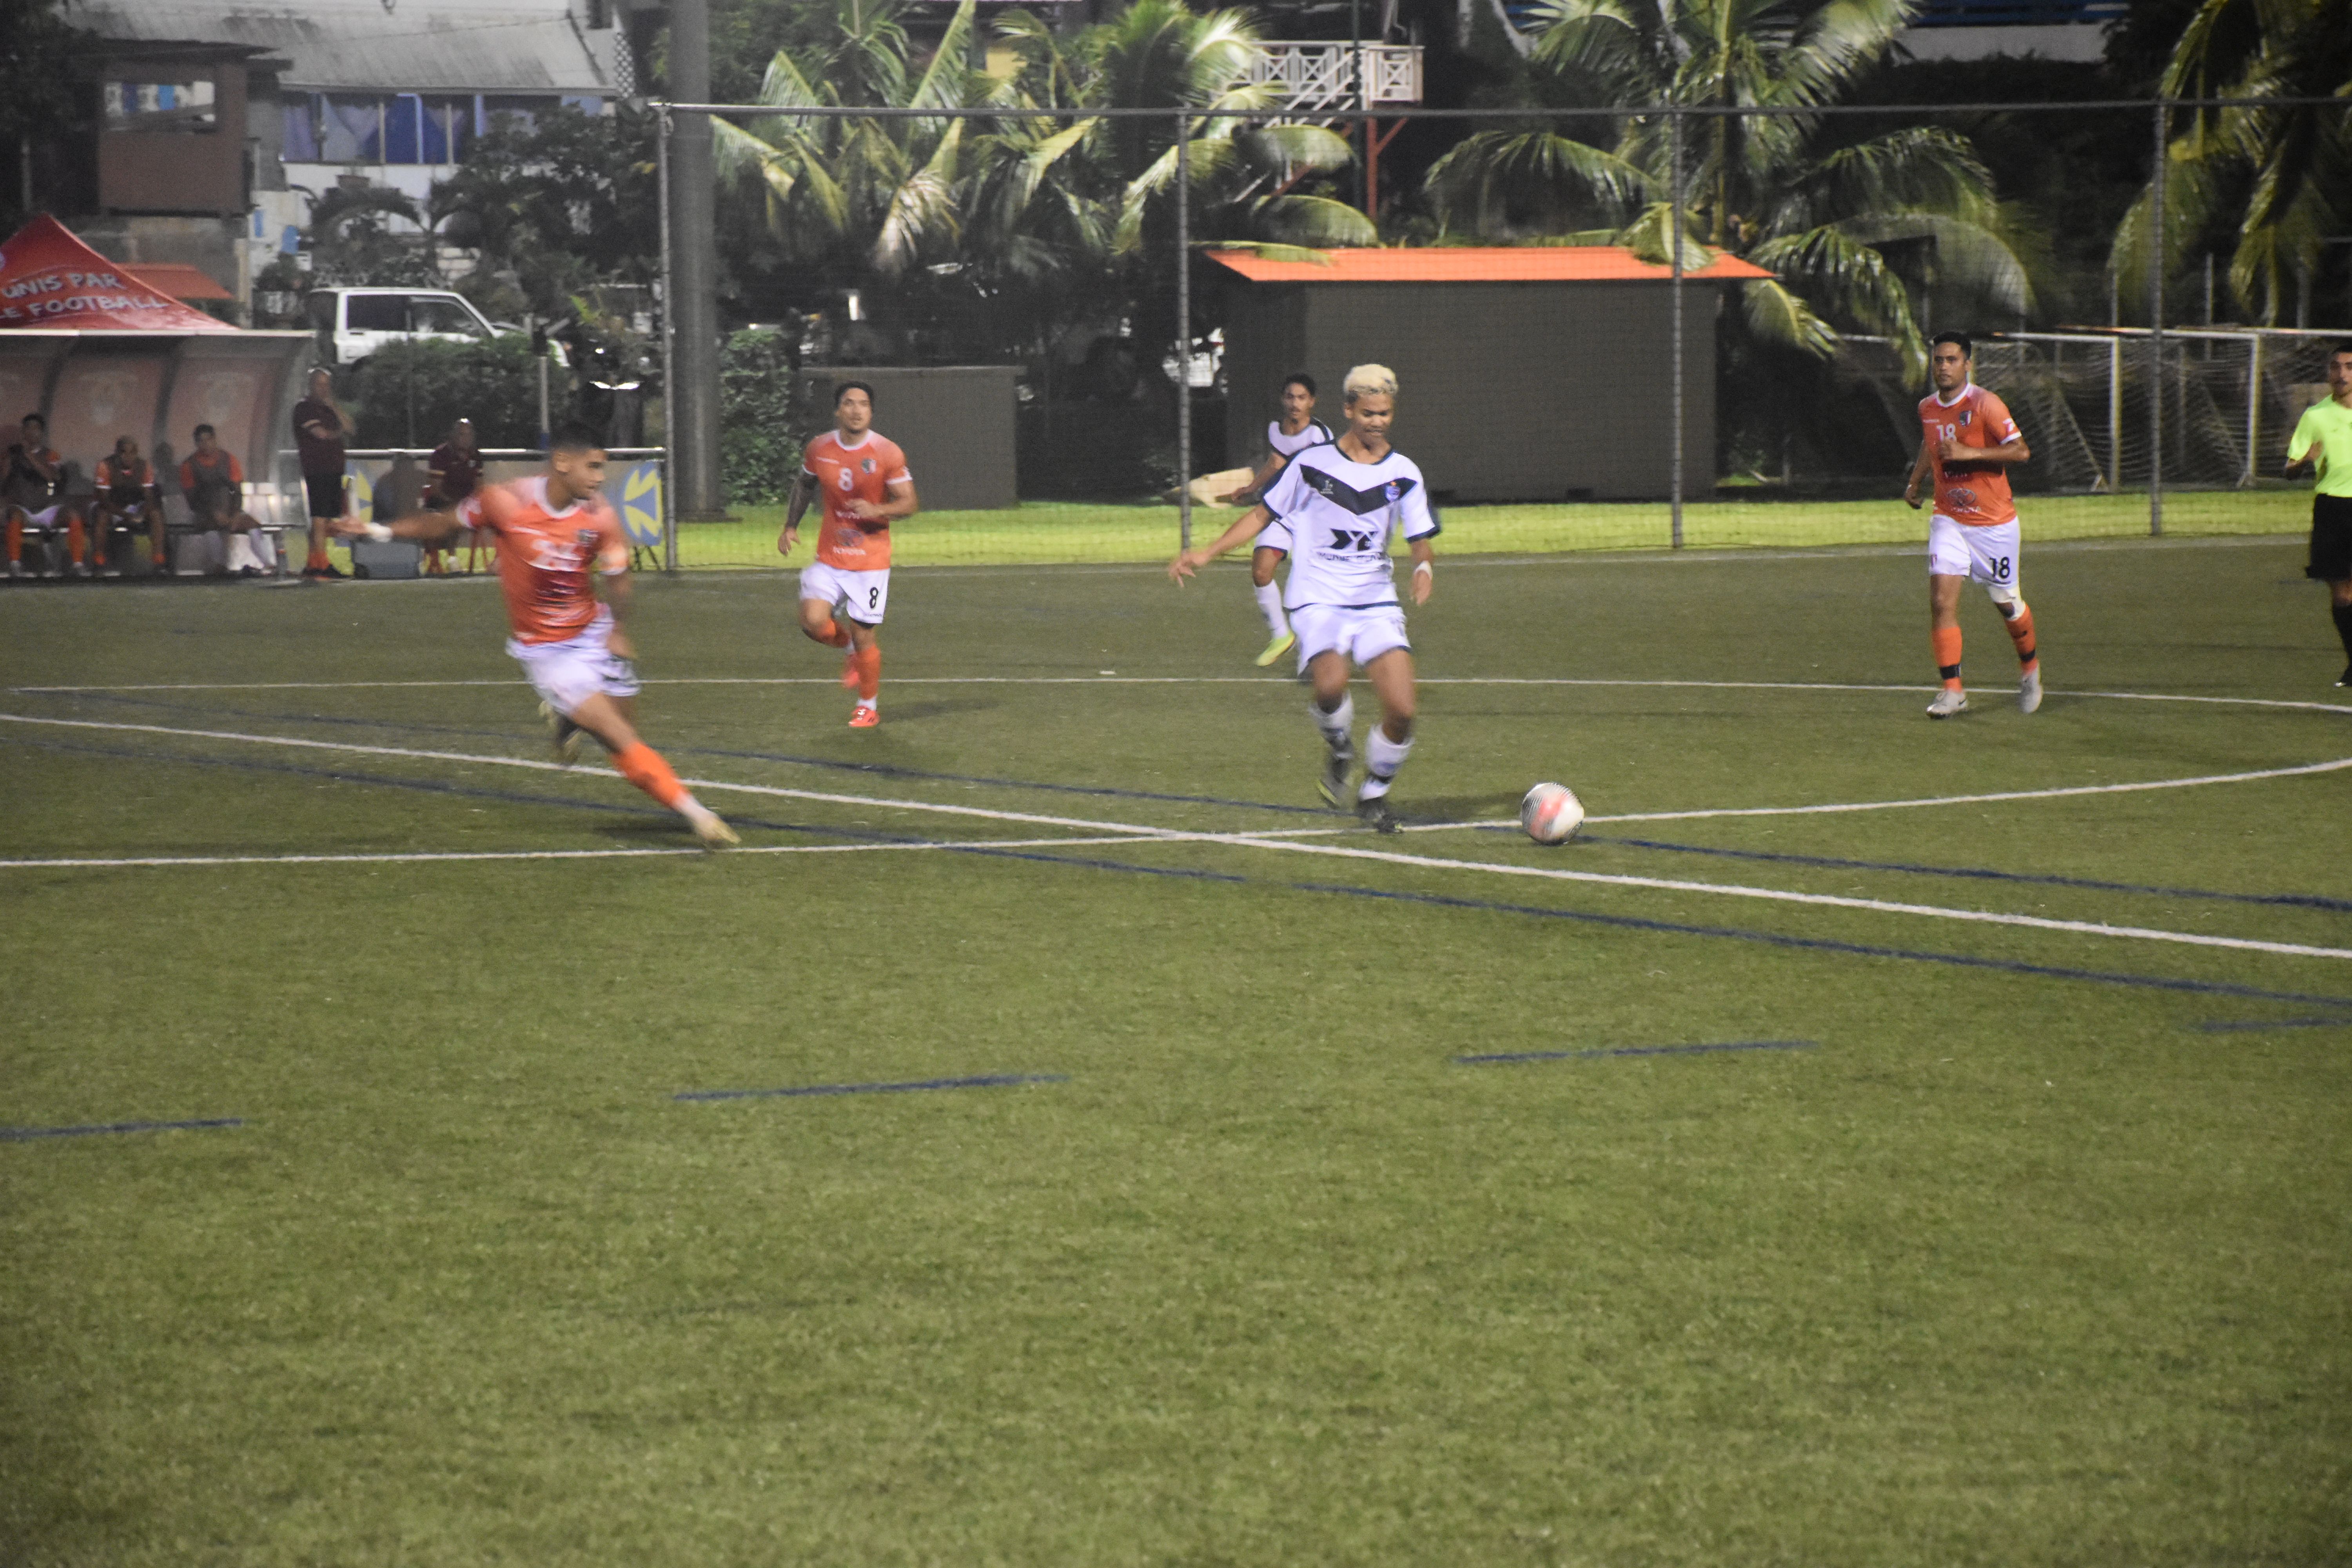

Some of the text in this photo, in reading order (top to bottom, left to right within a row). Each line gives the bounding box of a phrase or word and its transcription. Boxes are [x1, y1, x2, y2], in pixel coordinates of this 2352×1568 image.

[67, 273, 127, 289] PAR
[0, 296, 170, 319] E FOOTBALL
[1936, 423, 1957, 442] 18
[838, 468, 853, 491] 8
[1989, 556, 2010, 579] 18
[869, 586, 879, 609] 8
